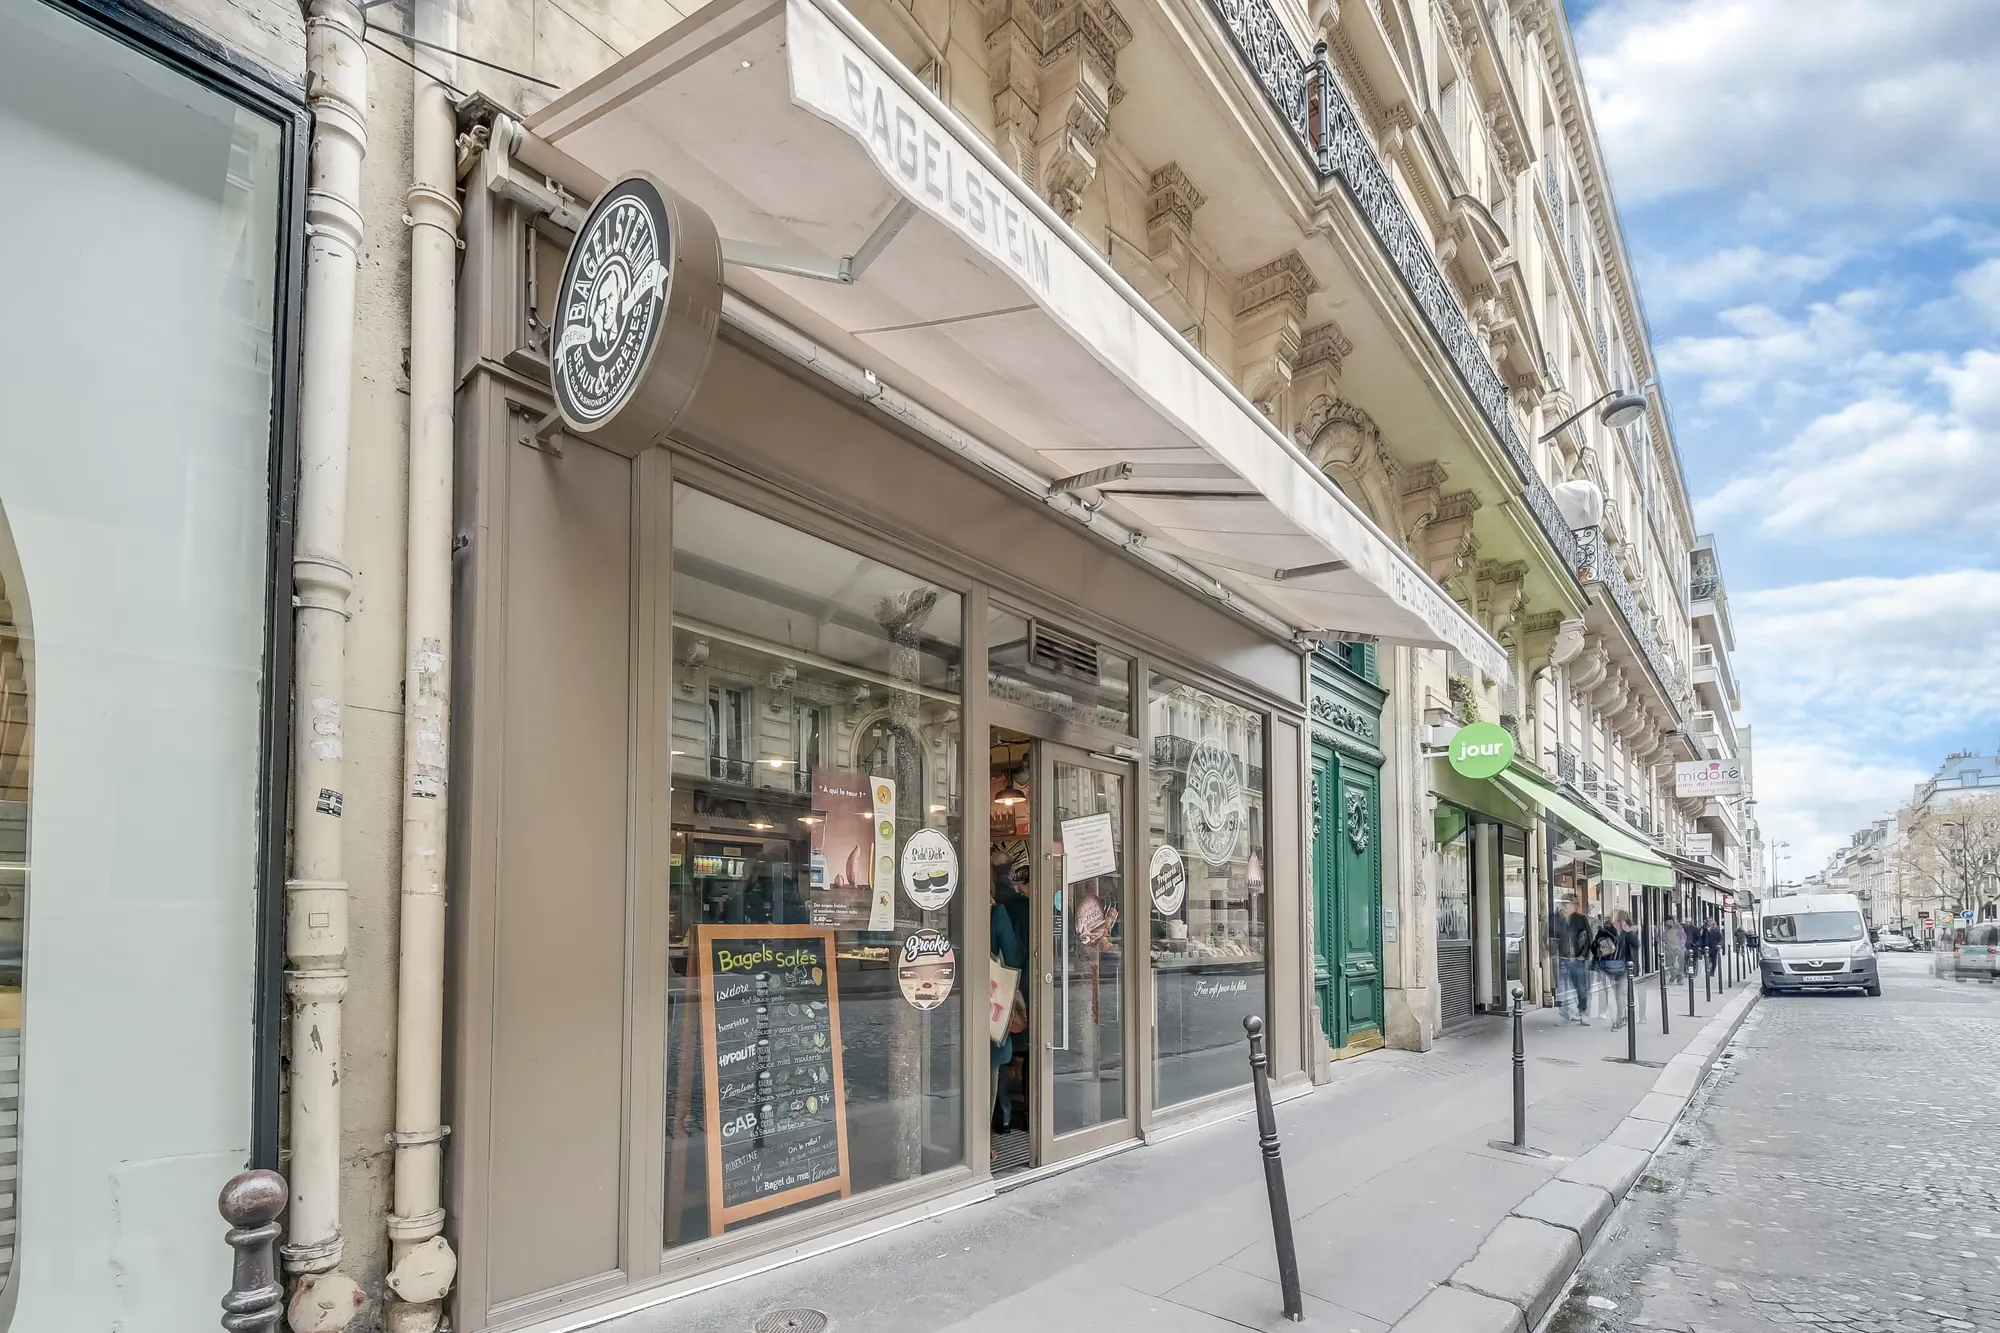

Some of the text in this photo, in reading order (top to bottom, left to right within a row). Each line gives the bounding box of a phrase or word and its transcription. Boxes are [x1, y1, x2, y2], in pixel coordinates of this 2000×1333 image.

[842, 54, 1053, 294] BAGELSTEIN
[568, 205, 654, 322] BAGELSTEIN
[631, 267, 655, 302] 1789
[572, 302, 643, 397] BEAUX & FRÈRES
[607, 344, 641, 401] HOMEMADE
[638, 300, 652, 346] BAGEL
[1391, 561, 1408, 602] THE
[1456, 741, 1504, 761] jour
[1678, 766, 1739, 783] midoré
[829, 787, 839, 796] qui
[839, 788, 845, 796] le
[846, 790, 858, 798] tour
[718, 944, 818, 973] Bagels Salés
[905, 933, 951, 961] Brookie
[716, 983, 750, 1002] isidore
[722, 1112, 758, 1138] GAB
[787, 1145, 798, 1154] On
[763, 1176, 786, 1191] Bagel
[785, 1174, 795, 1183] du
